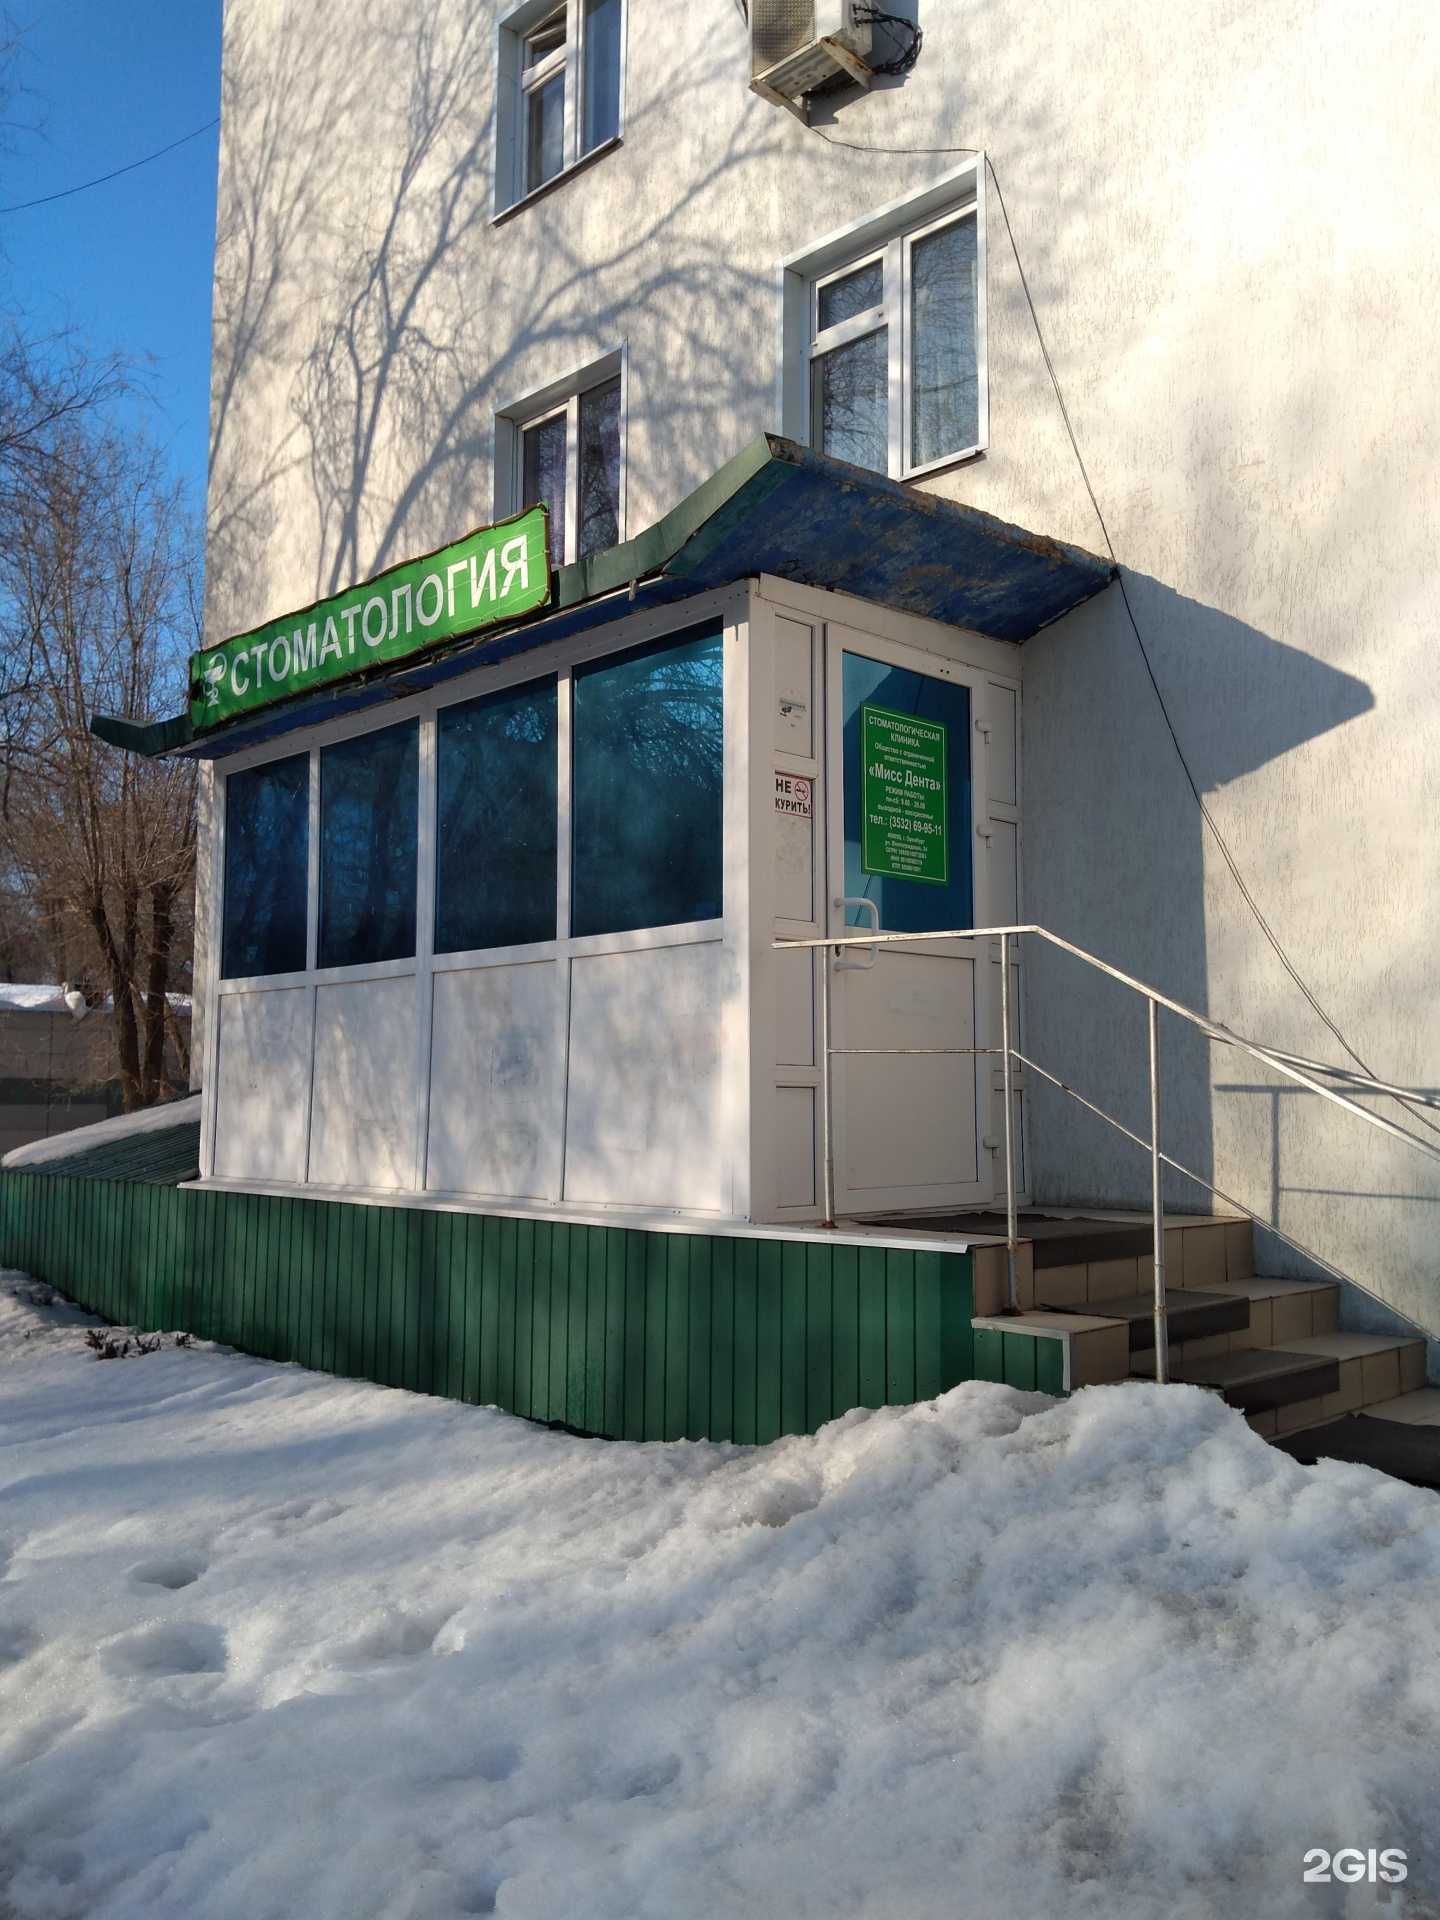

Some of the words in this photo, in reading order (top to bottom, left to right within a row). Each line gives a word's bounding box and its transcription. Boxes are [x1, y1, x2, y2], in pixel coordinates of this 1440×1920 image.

[231, 534, 529, 697] СТОМАТОЛОГИЯ
[868, 715, 940, 742] СТОМАТОЛОГИЧЕСКАЯ
[890, 732, 920, 748] КЛИНИКА
[775, 778, 792, 794] НЕ
[869, 763, 903, 783] «Мисс
[905, 769, 941, 790] Дента»
[775, 797, 811, 815] КУРИТЬ!
[889, 815, 912, 833] (3532)
[912, 820, 942, 836] 69-95-11
